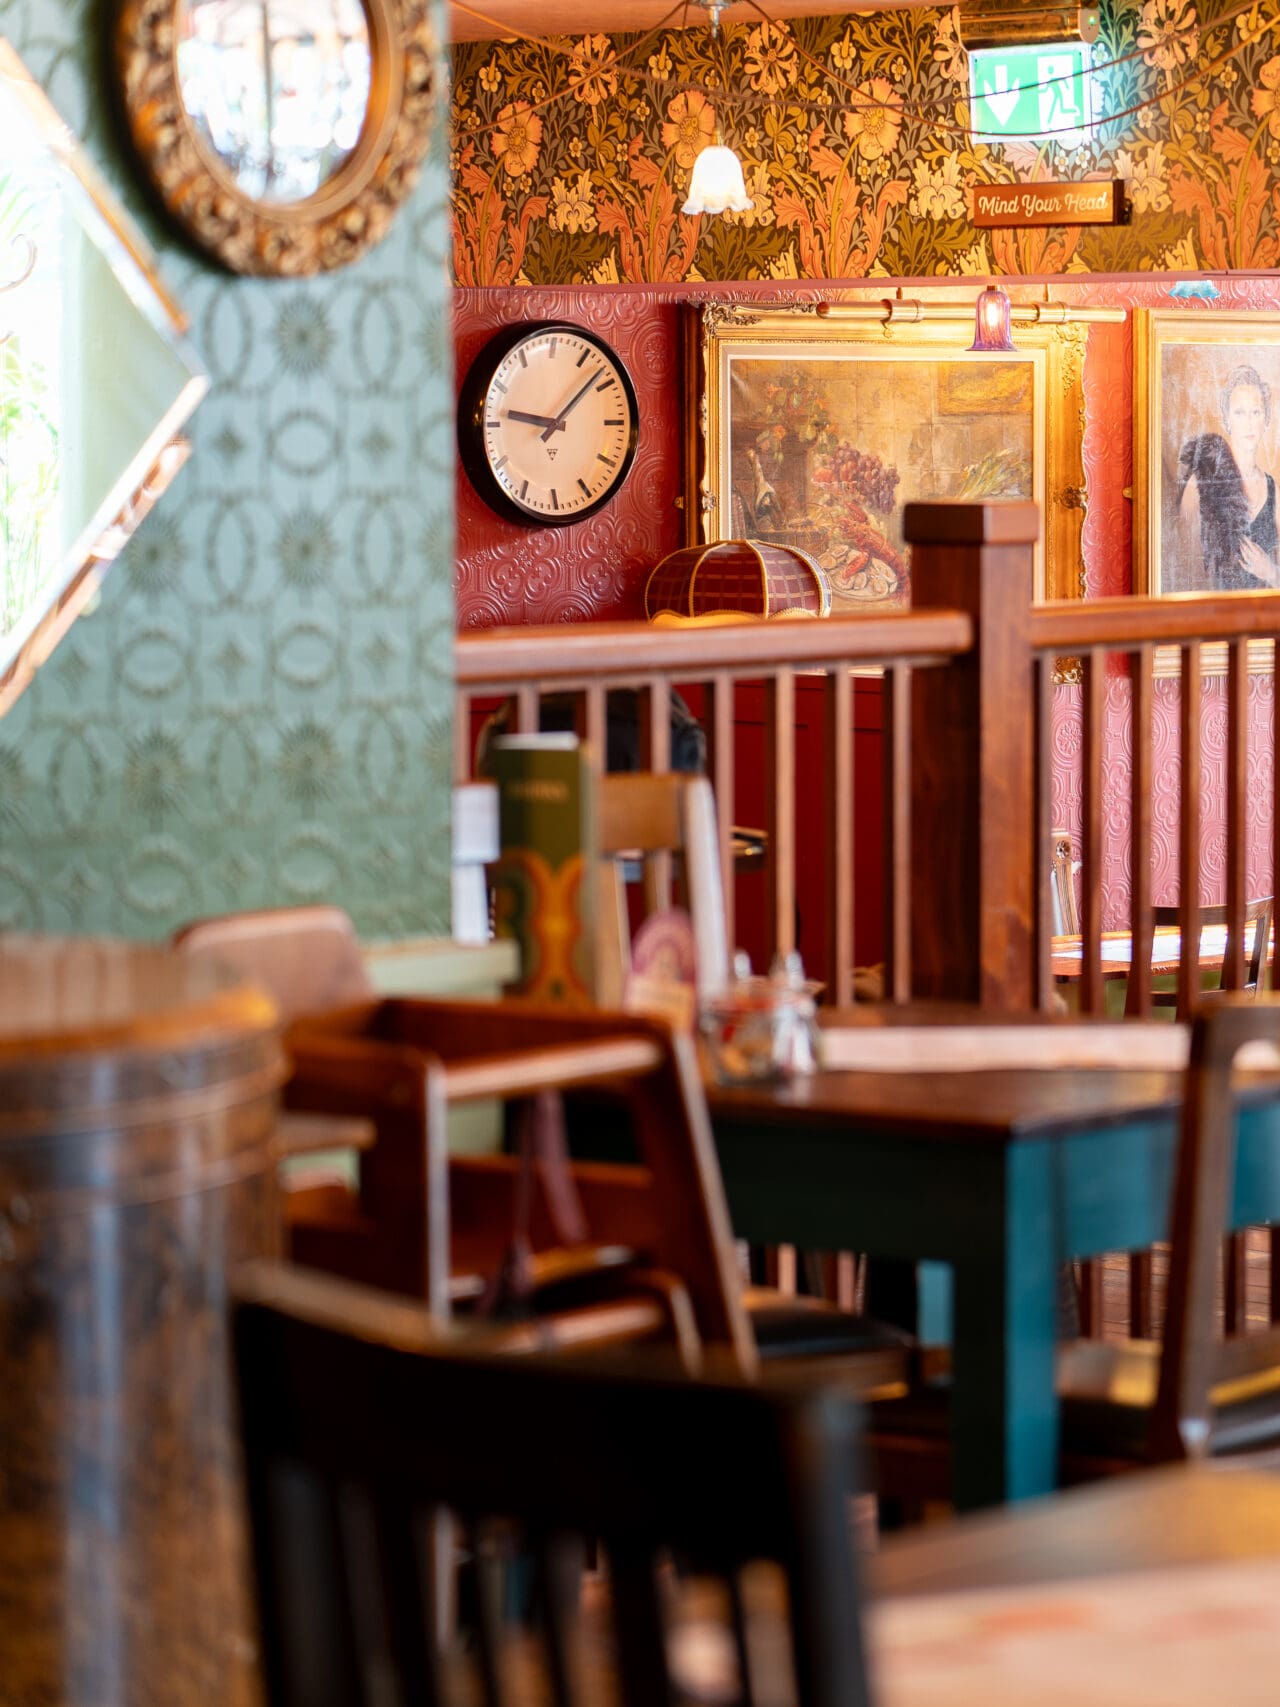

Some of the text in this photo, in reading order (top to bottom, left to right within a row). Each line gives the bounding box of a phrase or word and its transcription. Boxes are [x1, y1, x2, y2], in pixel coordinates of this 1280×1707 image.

[978, 191, 1108, 217] Mind Your Head
